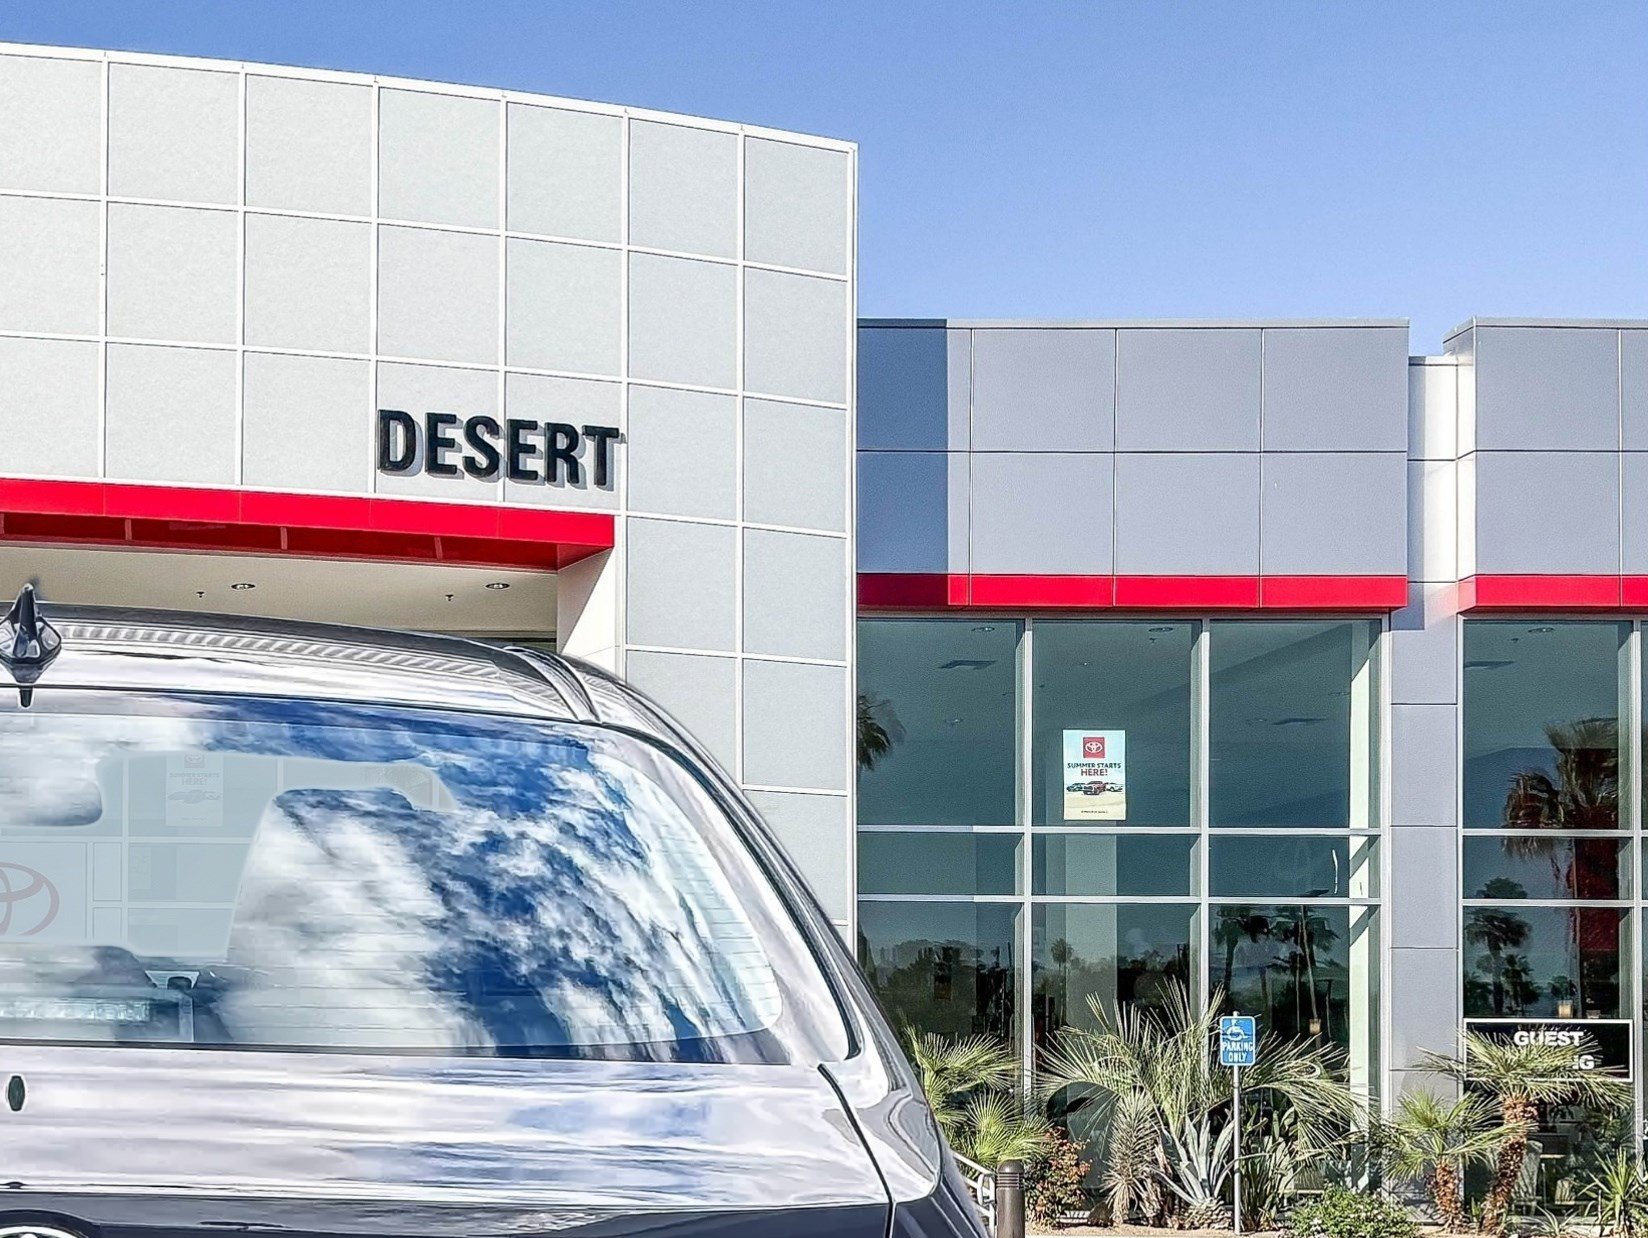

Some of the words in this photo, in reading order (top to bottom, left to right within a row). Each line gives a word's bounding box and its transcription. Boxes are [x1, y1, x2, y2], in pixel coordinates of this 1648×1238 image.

[377, 409, 619, 486] DESERT
[1081, 768, 1108, 776] HERE!
[1513, 1030, 1584, 1047] GUEST
[1222, 1041, 1253, 1052] PARKING
[1228, 1052, 1247, 1063] ONLY
